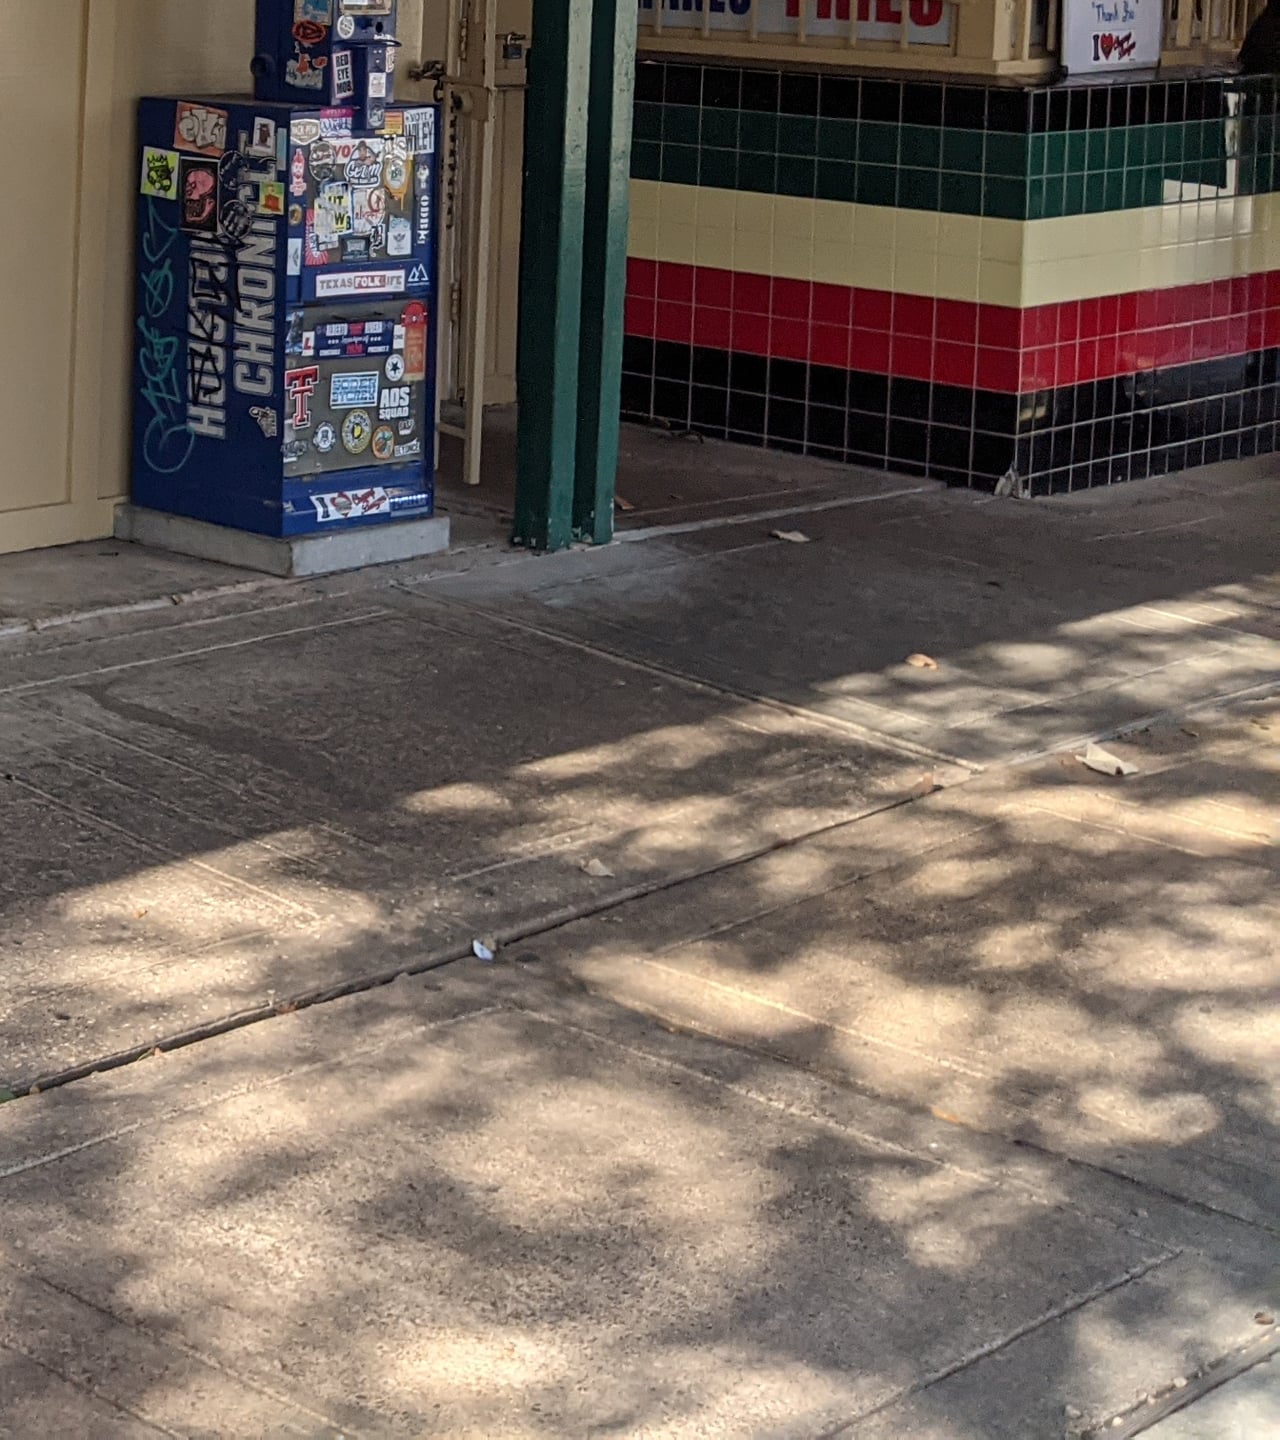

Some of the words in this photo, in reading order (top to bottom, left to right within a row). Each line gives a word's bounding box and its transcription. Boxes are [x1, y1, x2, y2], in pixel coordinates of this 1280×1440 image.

[336, 53, 350, 66] RED
[337, 67, 350, 81] EYE
[410, 111, 429, 122] VOTE
[319, 276, 353, 291] TEXAS
[379, 407, 409, 420] SQUAD
